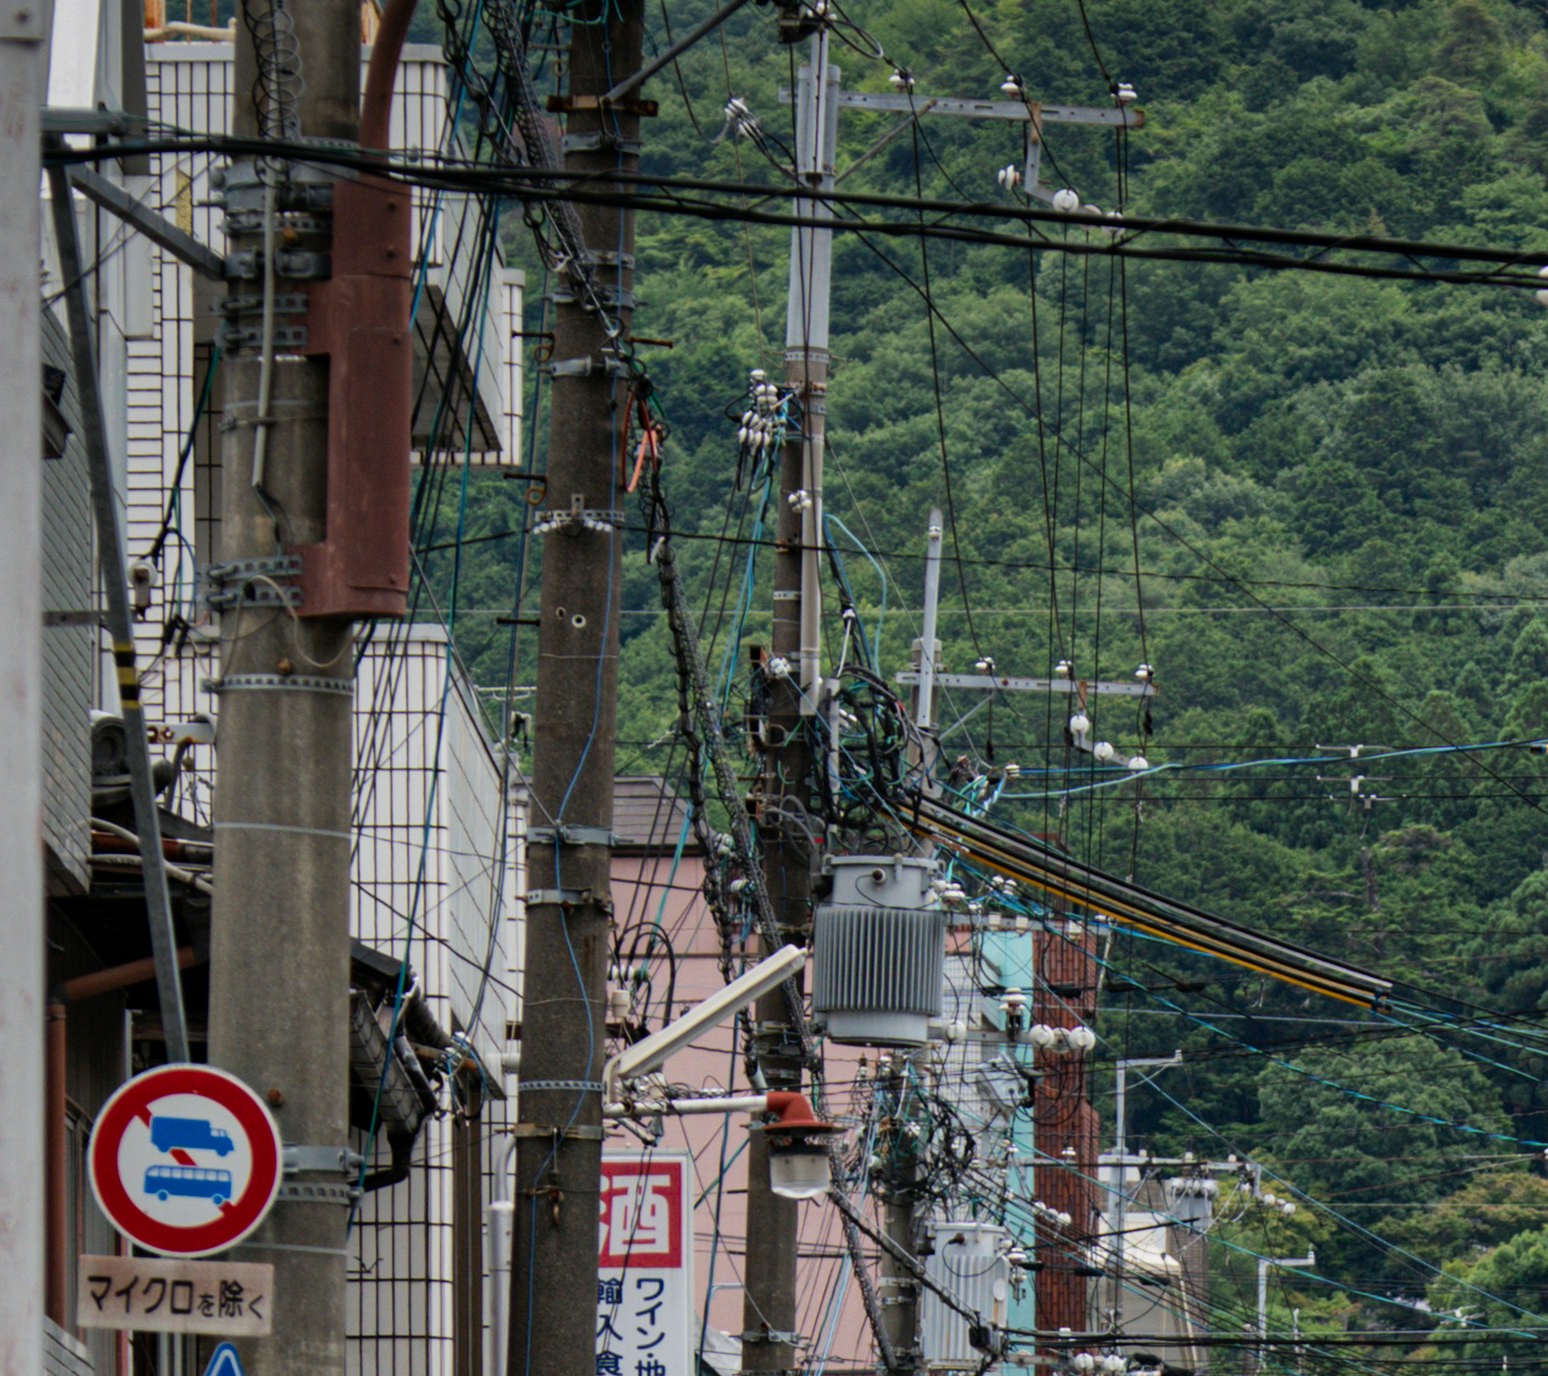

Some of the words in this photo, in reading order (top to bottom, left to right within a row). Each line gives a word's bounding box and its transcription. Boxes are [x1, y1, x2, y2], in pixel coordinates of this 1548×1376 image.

[599, 1173, 672, 1256] 酒
[87, 1275, 264, 1320] マイクロを除く
